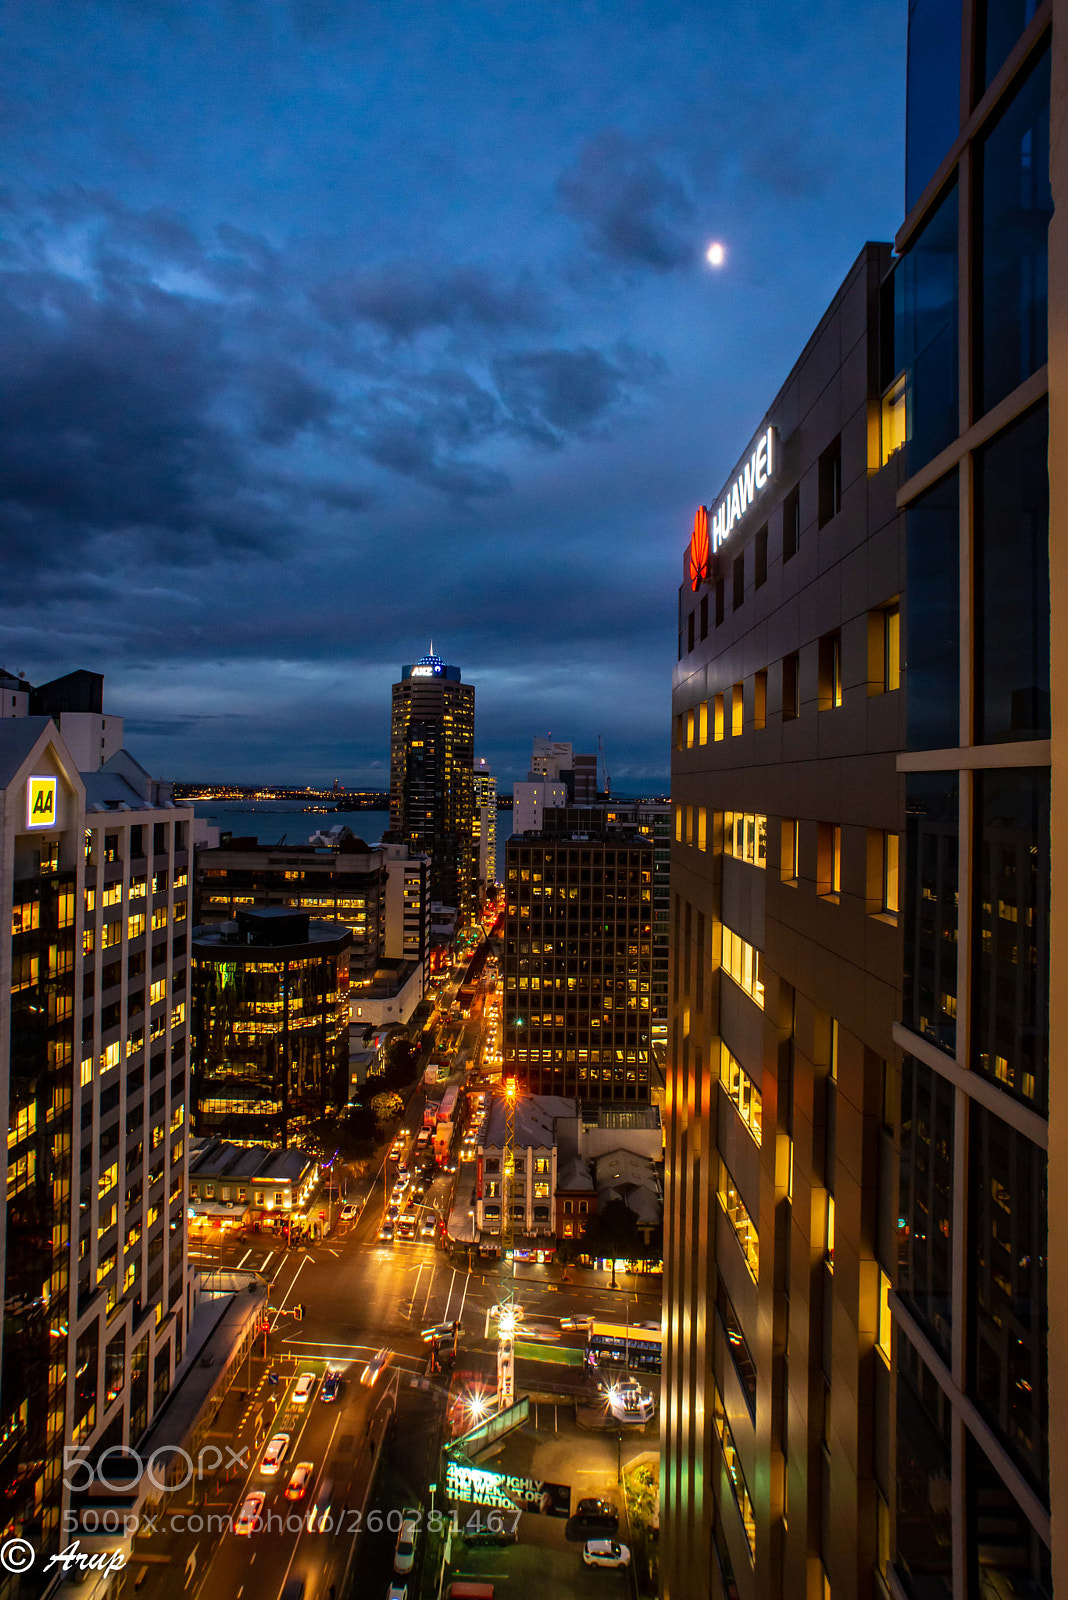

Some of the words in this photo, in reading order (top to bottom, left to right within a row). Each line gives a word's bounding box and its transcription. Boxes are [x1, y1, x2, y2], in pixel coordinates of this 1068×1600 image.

[712, 426, 773, 554] HUAWEI
[32, 790, 53, 814] AA
[279, 1413, 299, 1431] BUS
[446, 1476, 471, 1491] THE
[473, 1478, 524, 1497] WEIT
[446, 1487, 471, 1502] THE
